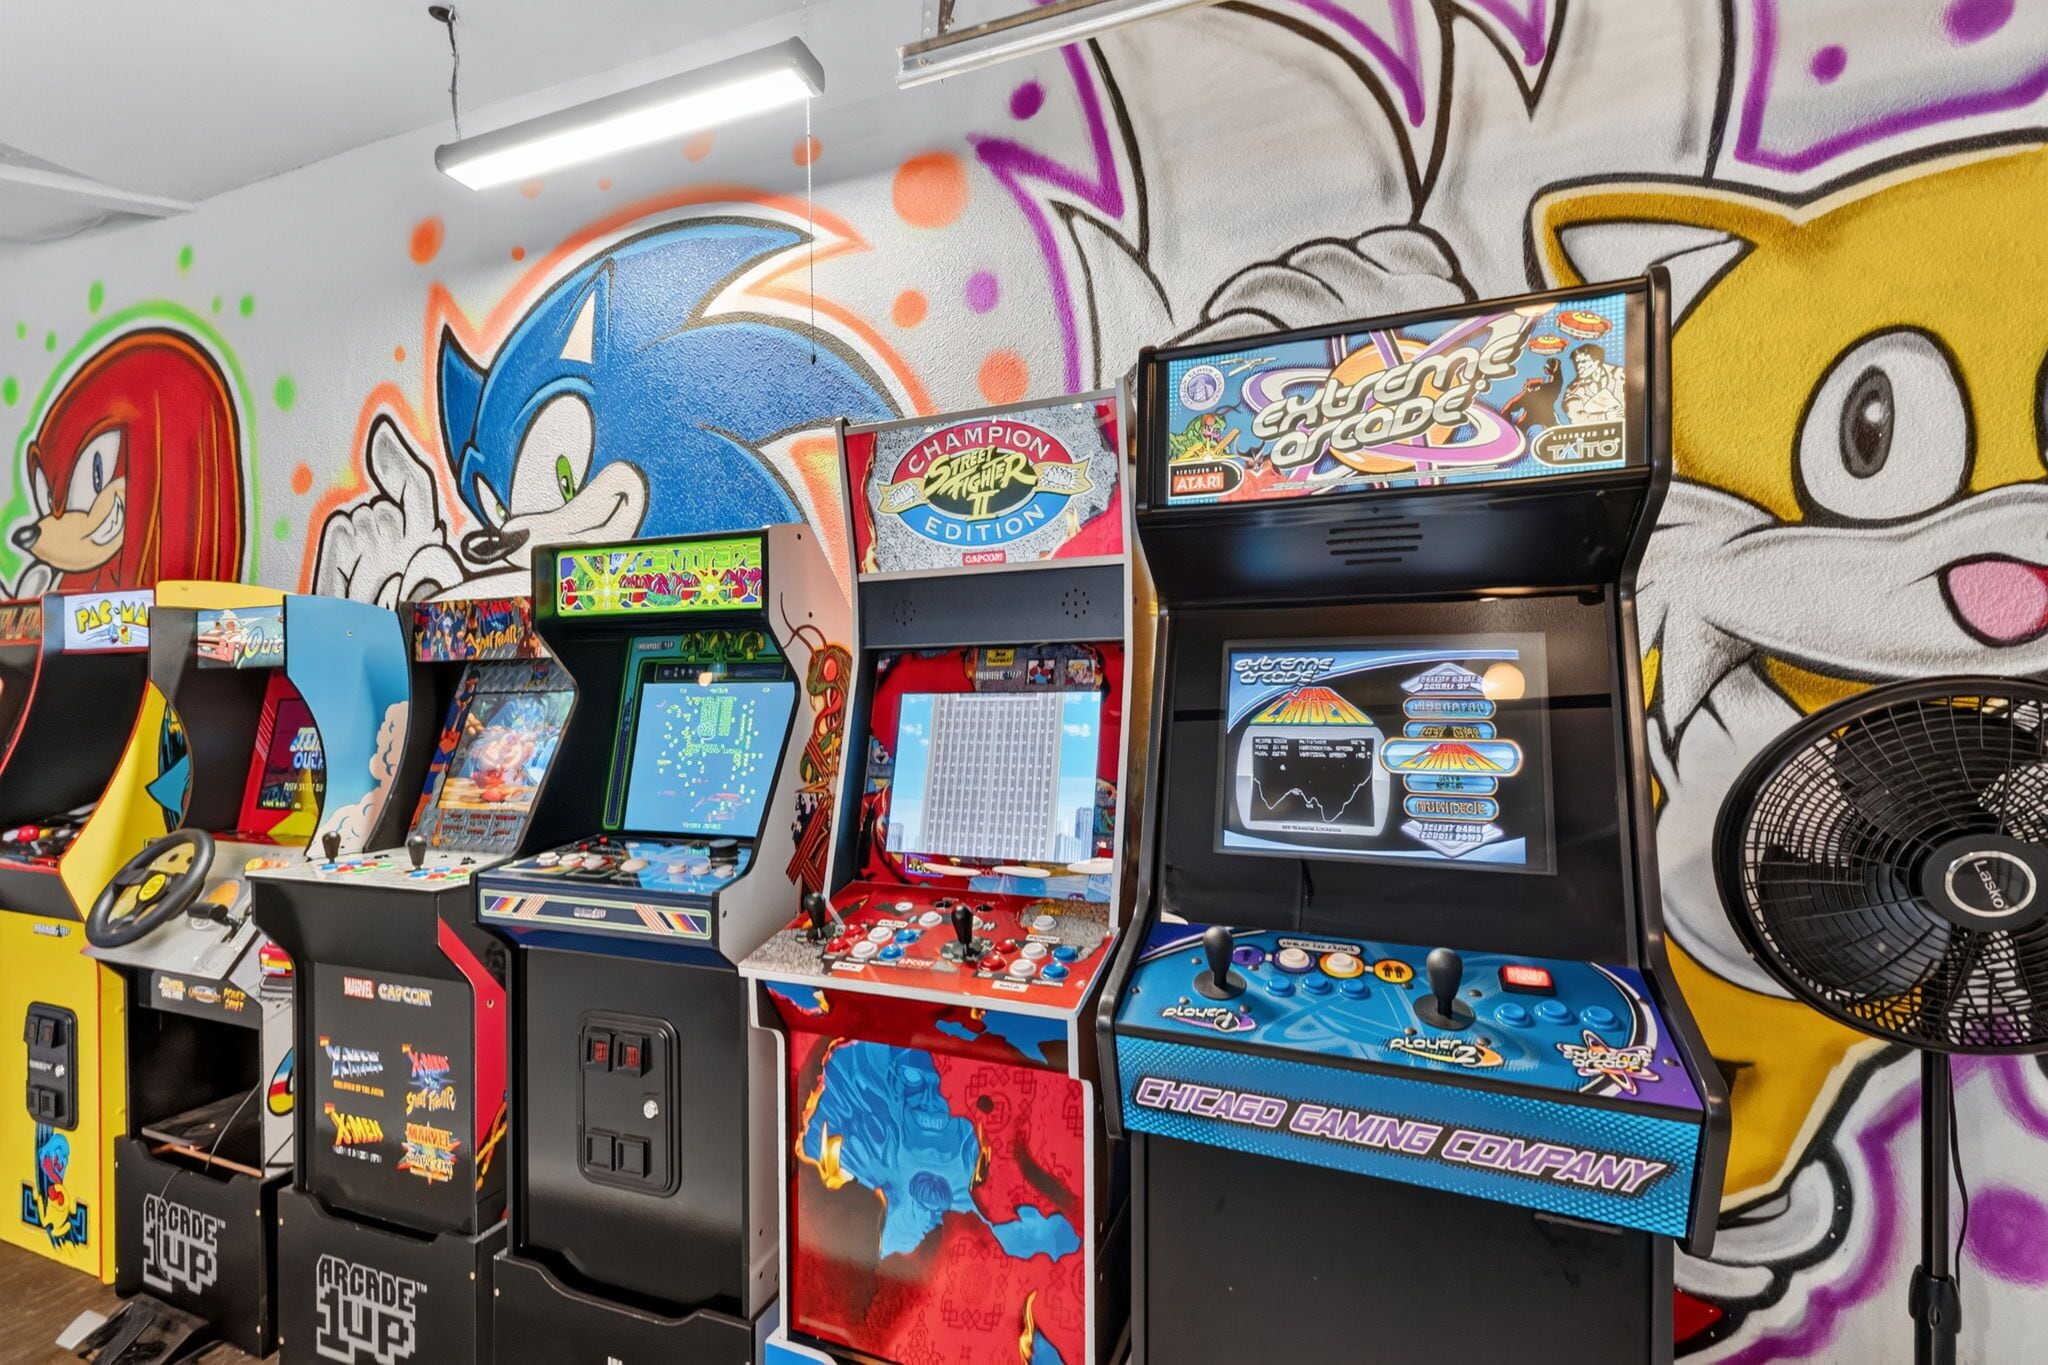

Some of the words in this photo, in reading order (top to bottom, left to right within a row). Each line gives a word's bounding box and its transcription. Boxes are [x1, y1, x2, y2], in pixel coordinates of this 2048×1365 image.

[908, 427, 1050, 474] CHAMPION
[1546, 437, 1621, 461] TAITO
[923, 444, 997, 500] STREET
[936, 452, 1038, 500] FIGHTER
[1176, 475, 1221, 492] ATARI
[925, 504, 1045, 541] EDITION
[966, 489, 1001, 521] II
[965, 553, 1003, 564] CAPCOM
[75, 600, 149, 633] PAC-MA
[1973, 860, 2004, 909] Lasko
[344, 976, 375, 1000] MARVEL
[378, 982, 433, 1008] CAPCOM
[1454, 1045, 1477, 1064] 2
[325, 1103, 384, 1146] X-MEN
[1136, 1077, 1288, 1128] CHICAGO
[1289, 1103, 1443, 1154] GAMING
[1441, 1129, 1667, 1193] COMPANY
[143, 1193, 217, 1250] ARCADE
[143, 1222, 217, 1295] 1UP
[317, 1254, 416, 1318] ARCADE
[317, 1287, 416, 1365] 1UP
